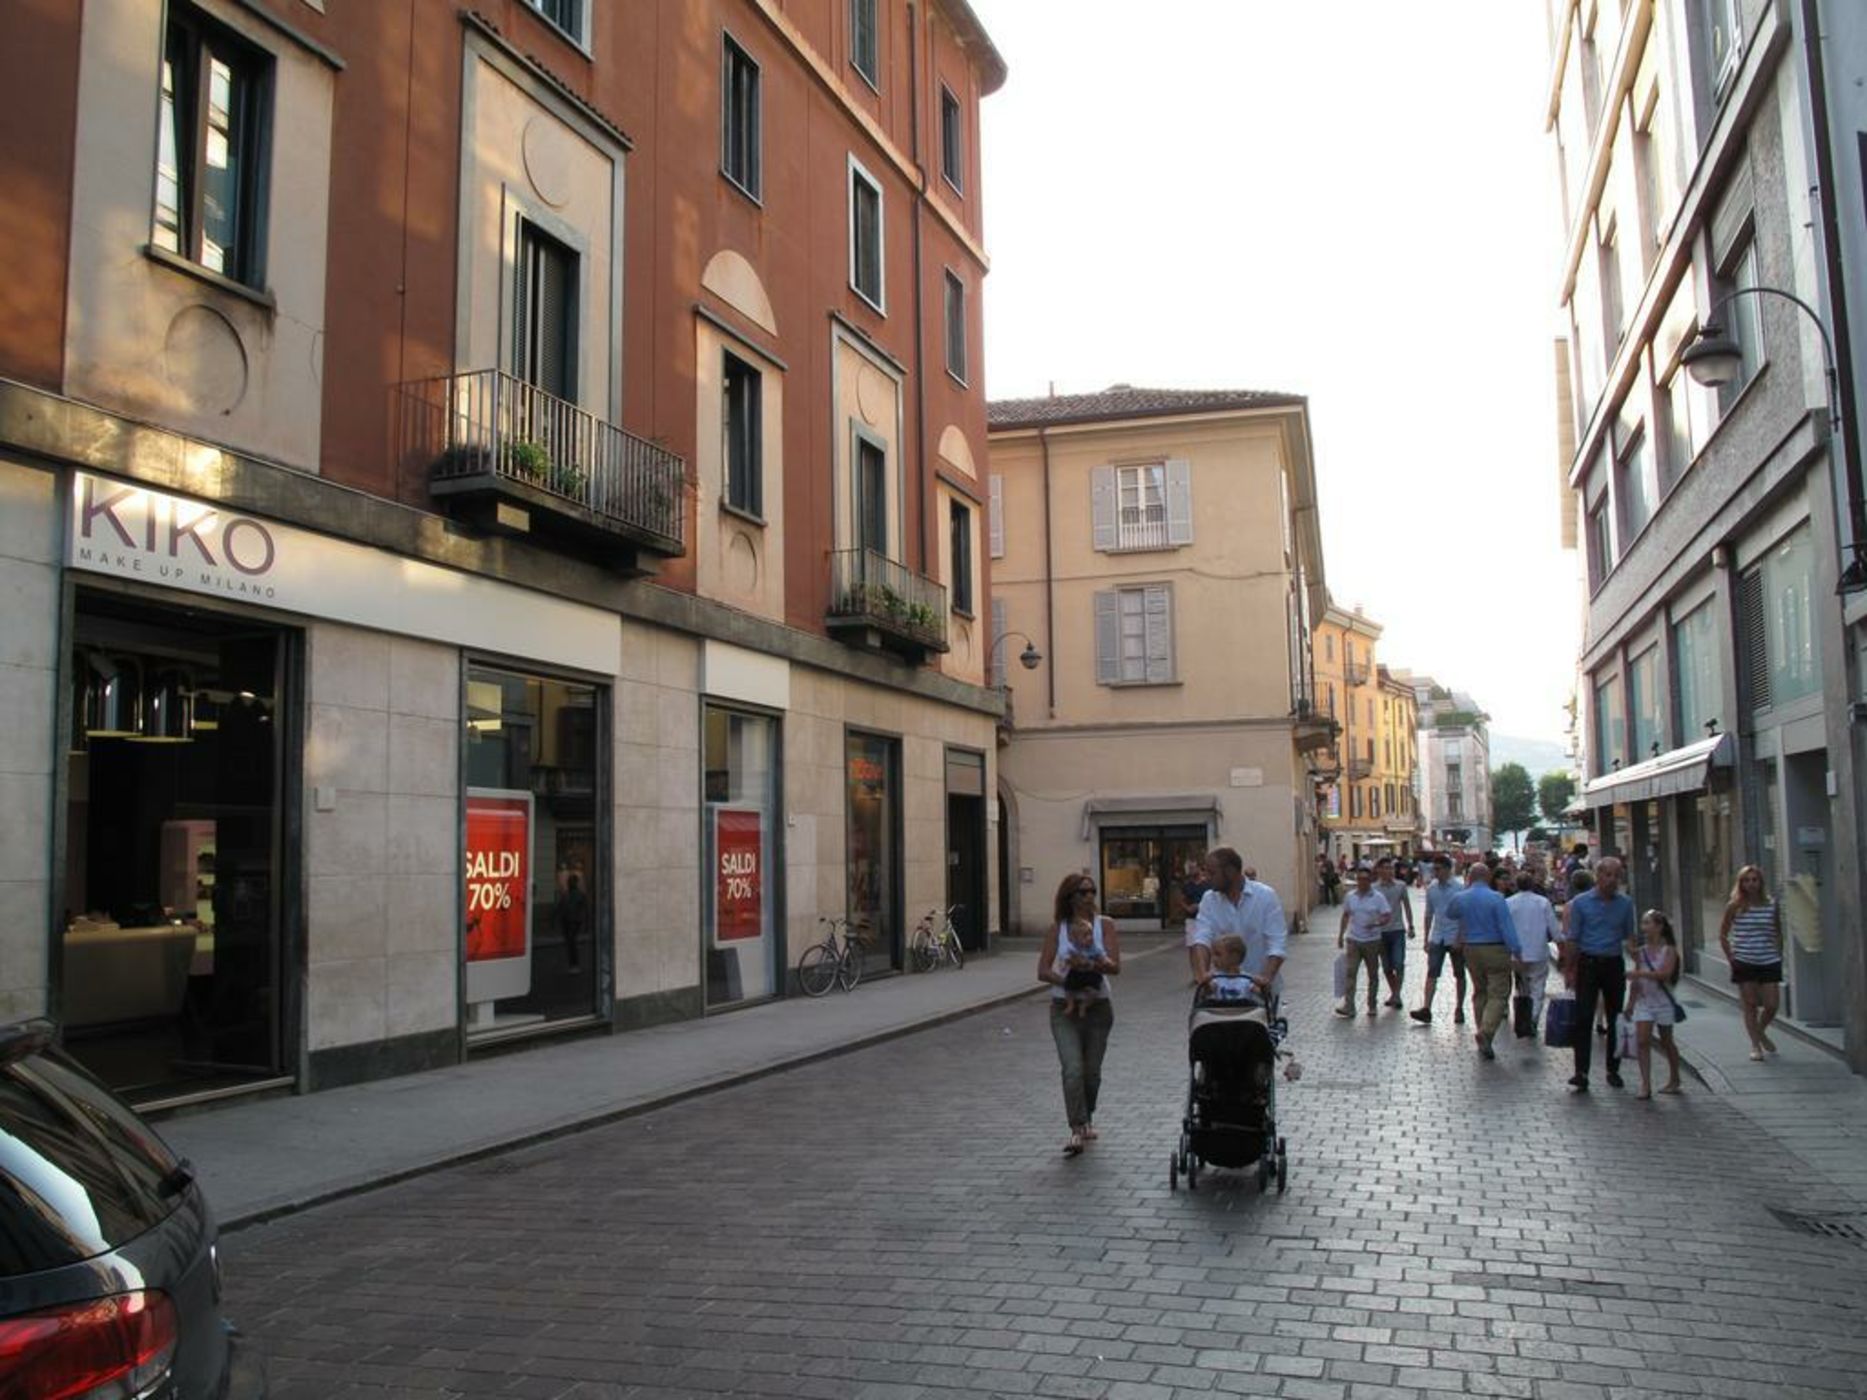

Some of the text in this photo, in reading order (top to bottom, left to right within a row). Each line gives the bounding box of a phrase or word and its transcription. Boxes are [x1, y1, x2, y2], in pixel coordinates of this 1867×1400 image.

[81, 477, 275, 576] KIKO
[79, 548, 275, 598] MAKE UP MILANO
[721, 852, 756, 875] SALDI
[468, 883, 512, 911] 70%
[726, 877, 752, 900] 70%
